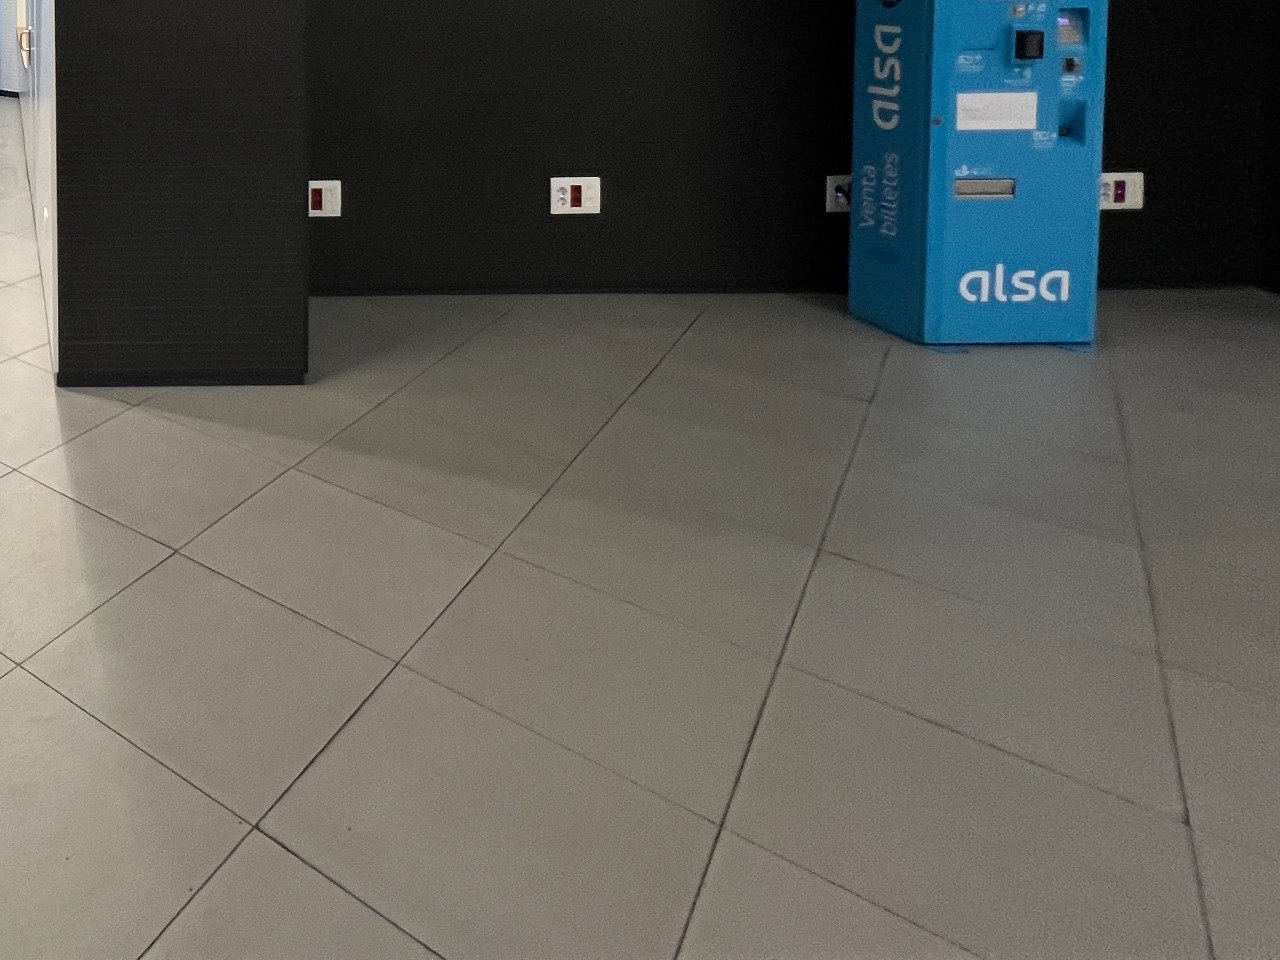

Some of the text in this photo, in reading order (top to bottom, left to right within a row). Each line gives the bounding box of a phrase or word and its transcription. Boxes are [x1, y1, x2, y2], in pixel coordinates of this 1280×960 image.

[868, 24, 902, 131] alsa
[858, 164, 876, 228] venta
[880, 152, 899, 237] billetes
[959, 263, 1070, 303] alsa
